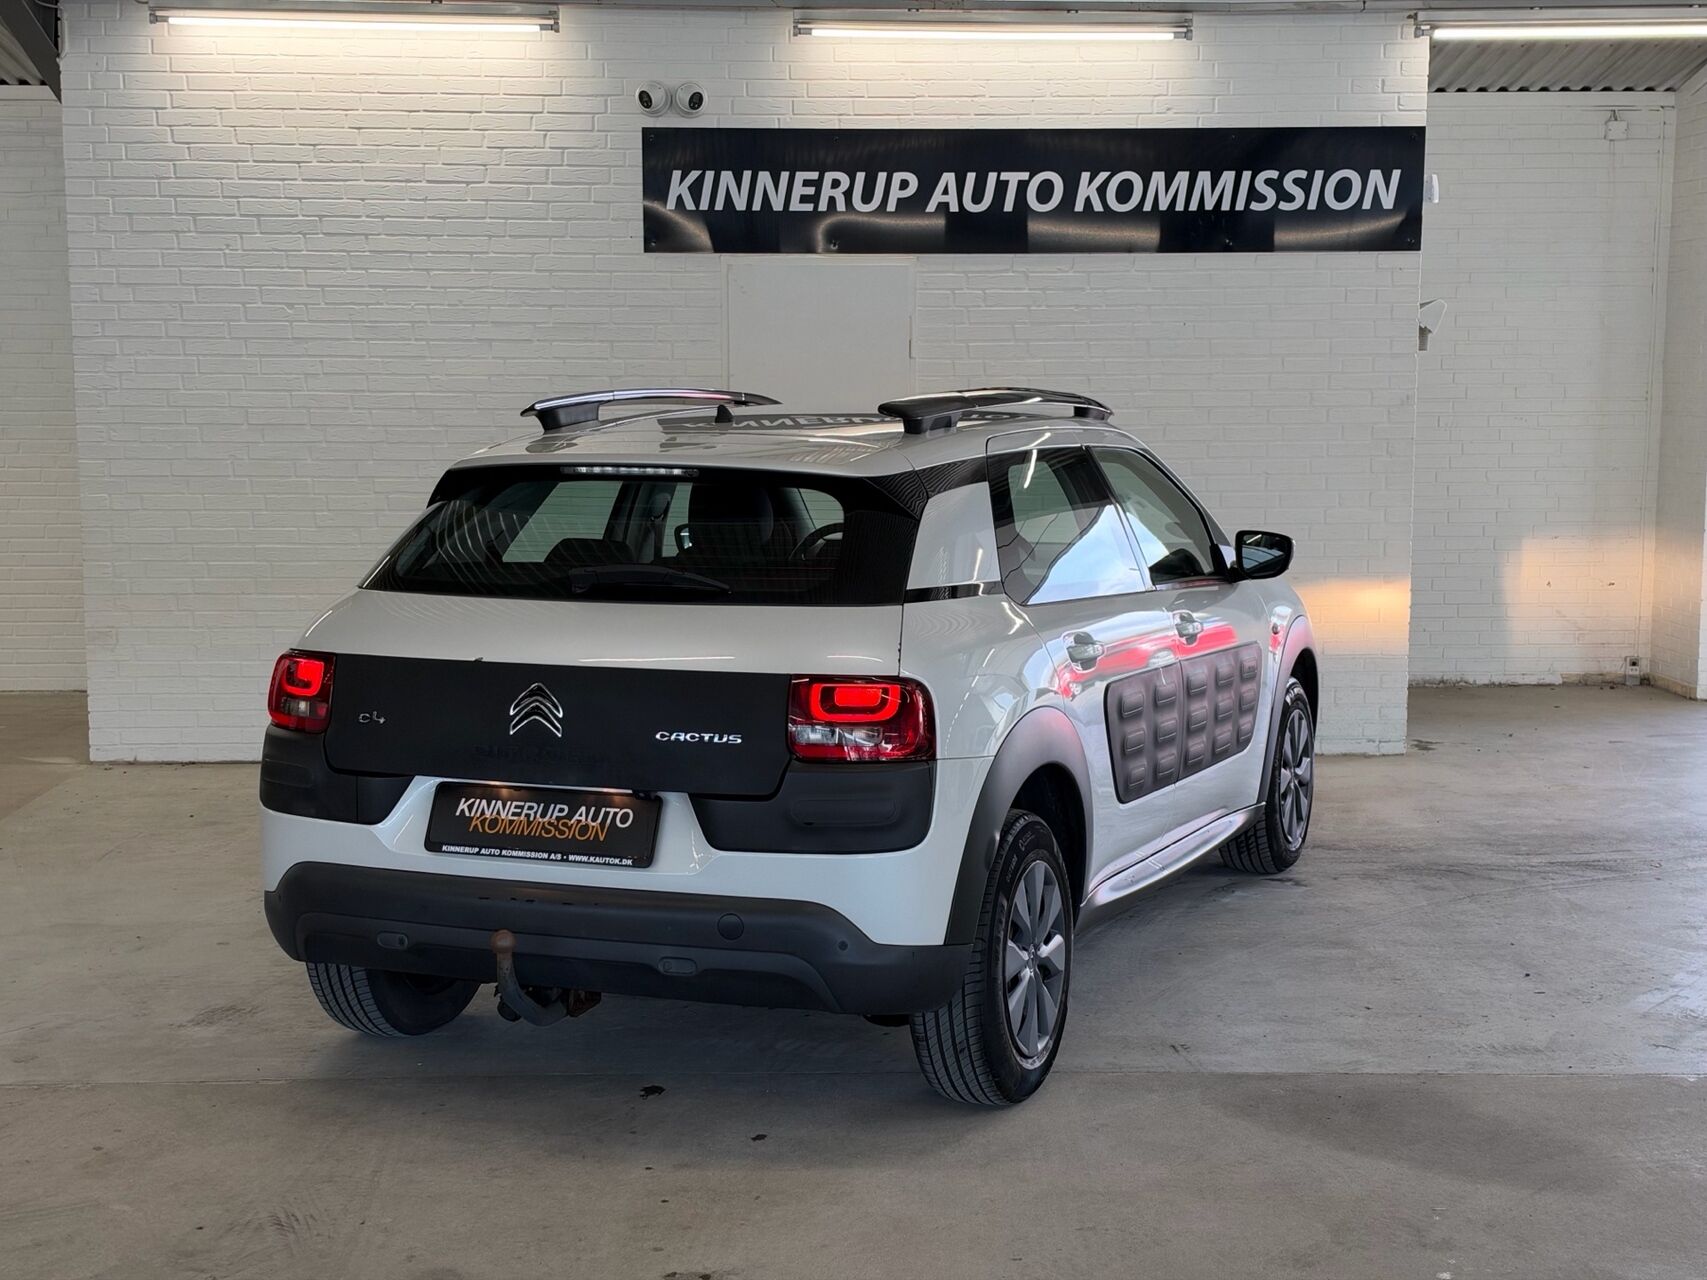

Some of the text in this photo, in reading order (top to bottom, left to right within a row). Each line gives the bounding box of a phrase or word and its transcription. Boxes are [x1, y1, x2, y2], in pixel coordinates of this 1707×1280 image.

[666, 168, 1402, 213] KINNERUP AUTO KOMMISSION
[359, 710, 386, 724] C4
[655, 731, 742, 744] CACTUS
[455, 797, 635, 828] KINNERUP AUTO
[468, 815, 610, 842] KOMMISSION
[442, 845, 633, 866] KINNERUP AUTO KOMMISSION A/S WWW.KAUTOK.DK
